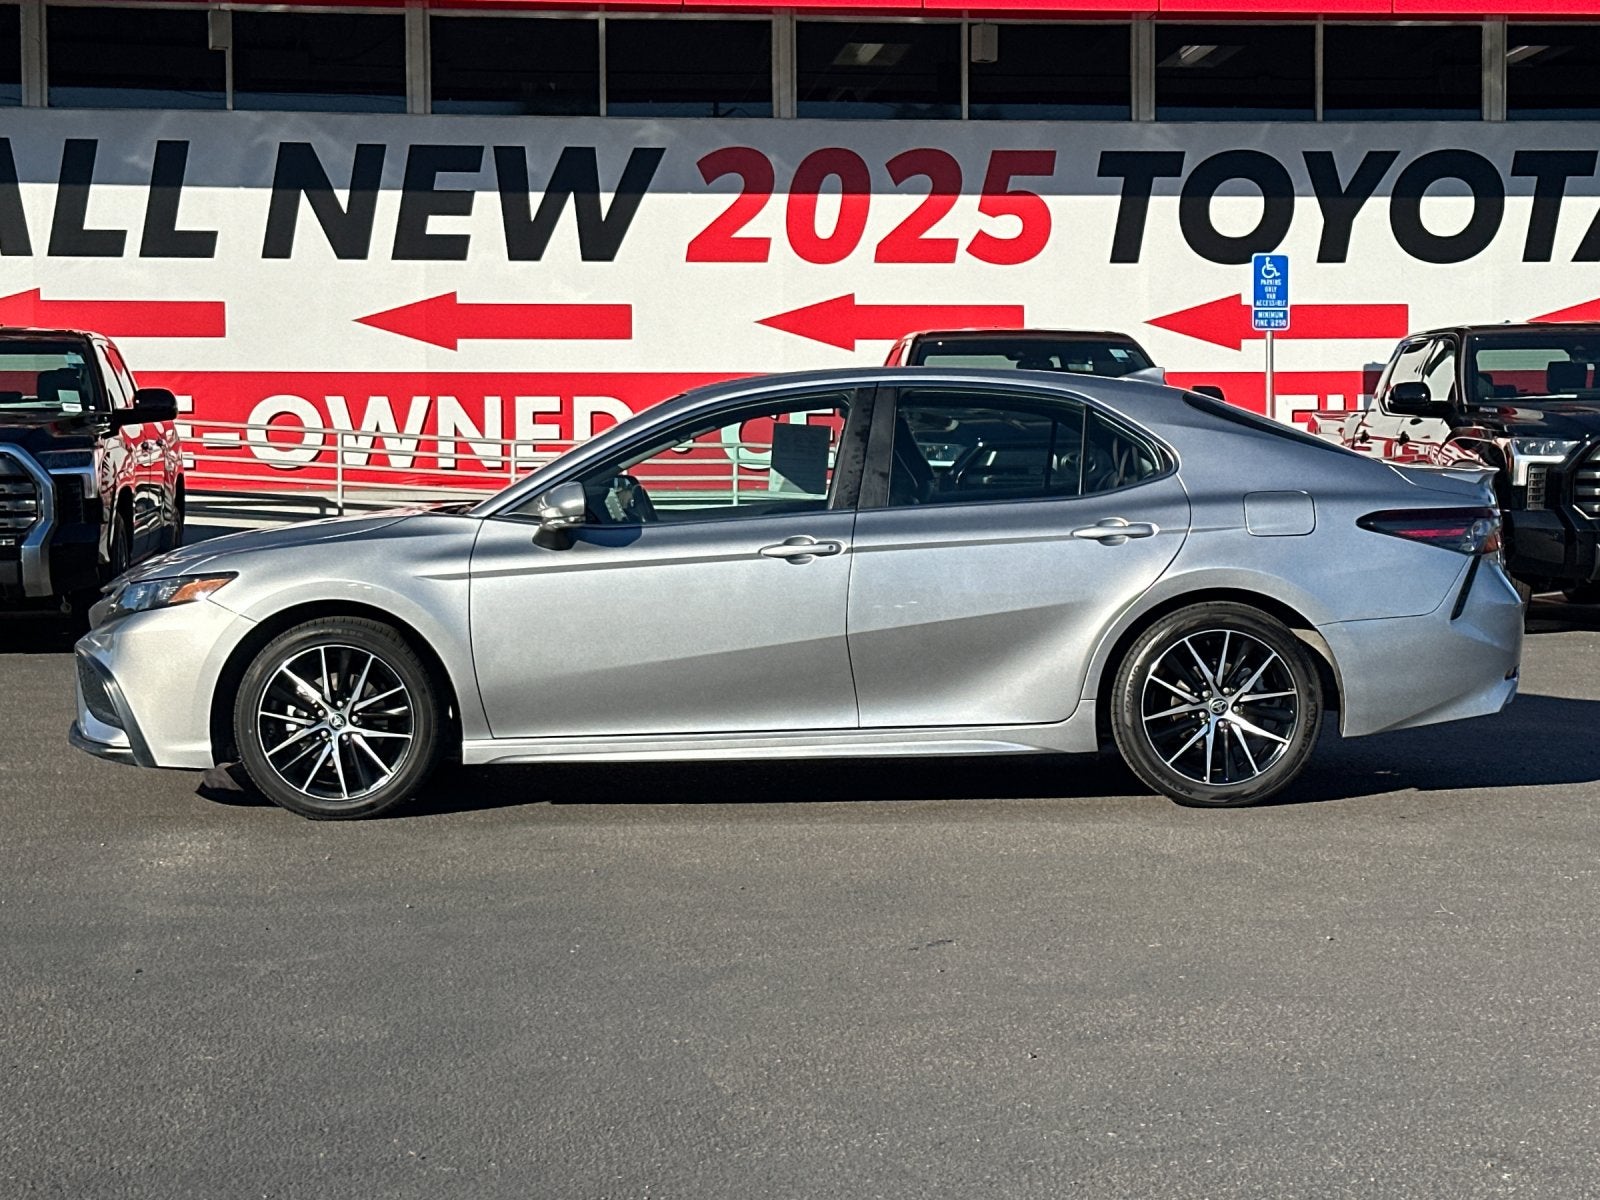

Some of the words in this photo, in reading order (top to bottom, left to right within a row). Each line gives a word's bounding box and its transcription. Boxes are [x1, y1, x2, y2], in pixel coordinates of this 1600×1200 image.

[261, 141, 666, 262] NEW
[685, 146, 1057, 265] 2025
[1097, 149, 1600, 264] TOYOT
[1255, 319, 1268, 327] FINE
